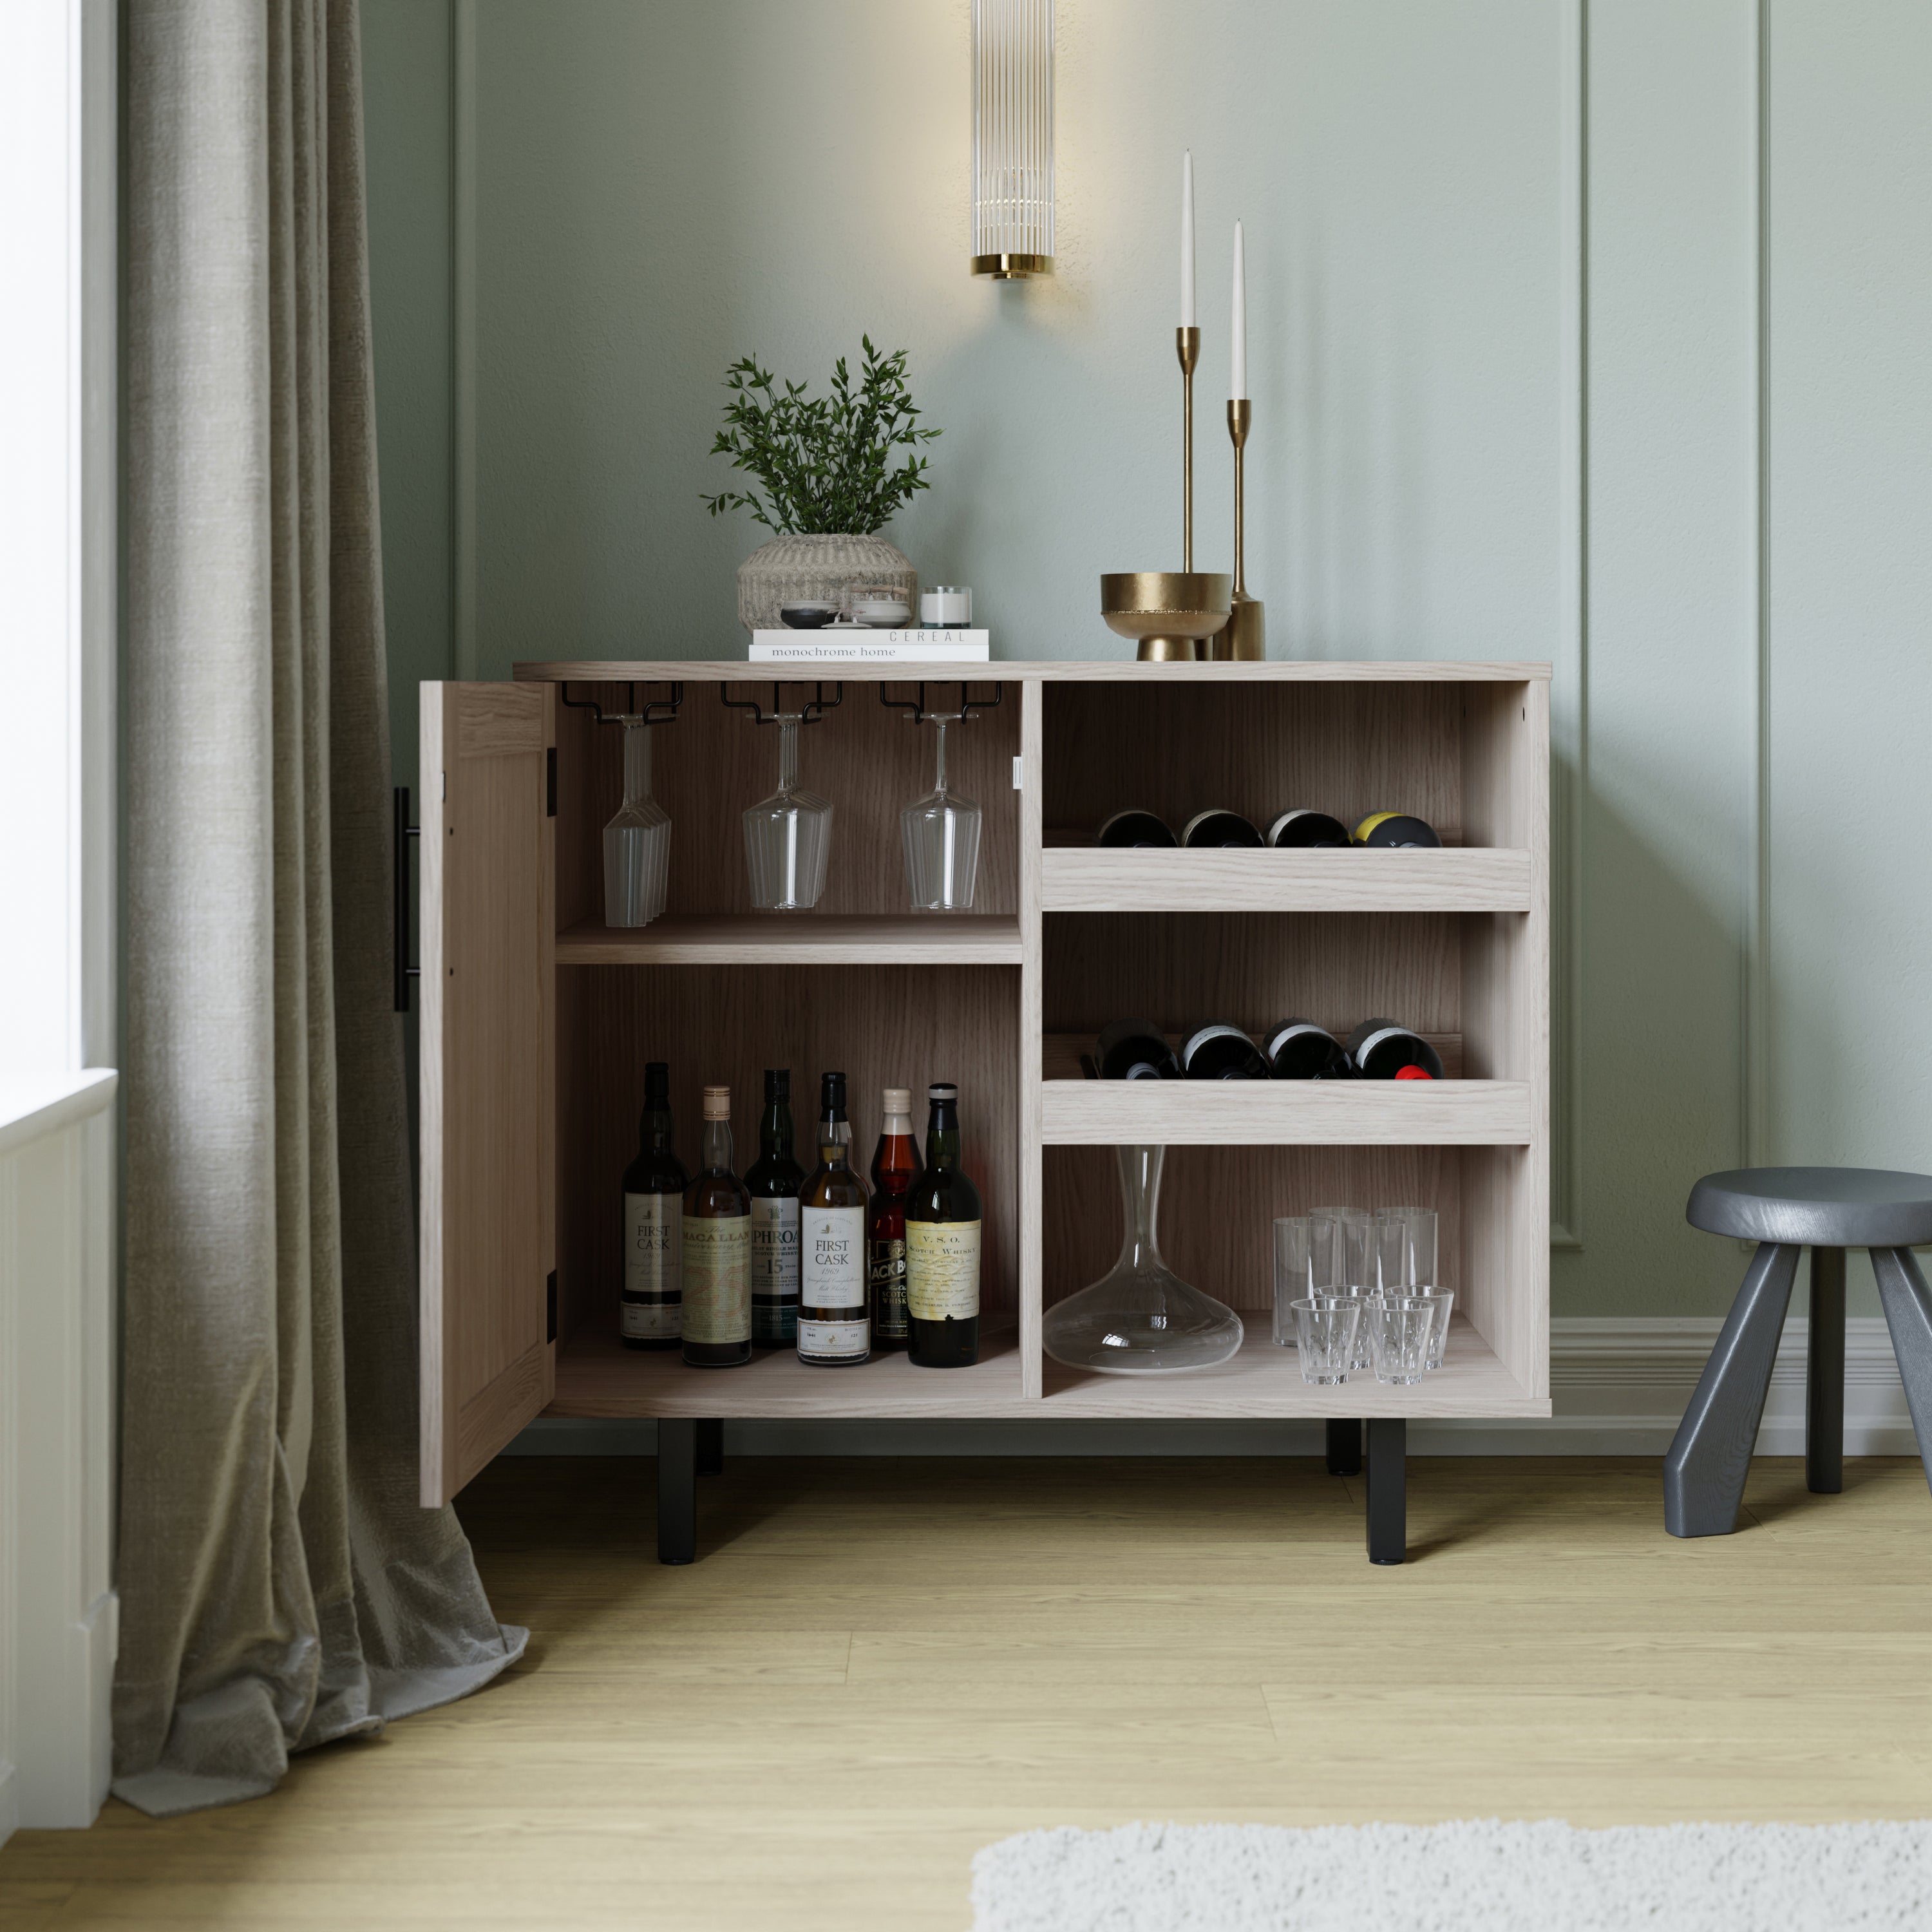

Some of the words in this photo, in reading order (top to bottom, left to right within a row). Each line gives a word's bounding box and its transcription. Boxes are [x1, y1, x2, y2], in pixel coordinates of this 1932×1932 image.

[889, 631, 965, 642] CEREAL
[772, 647, 856, 656] monochrome
[861, 646, 896, 656] home
[638, 1226, 670, 1236] FIRST
[683, 1231, 749, 1242] MACALLAN
[752, 1230, 797, 1244] PHRO
[637, 1239, 670, 1250] CASK
[815, 1240, 849, 1251] FIRST
[815, 1254, 849, 1265] CASK
[767, 1259, 783, 1274] 15
[871, 1262, 896, 1280] ACK
